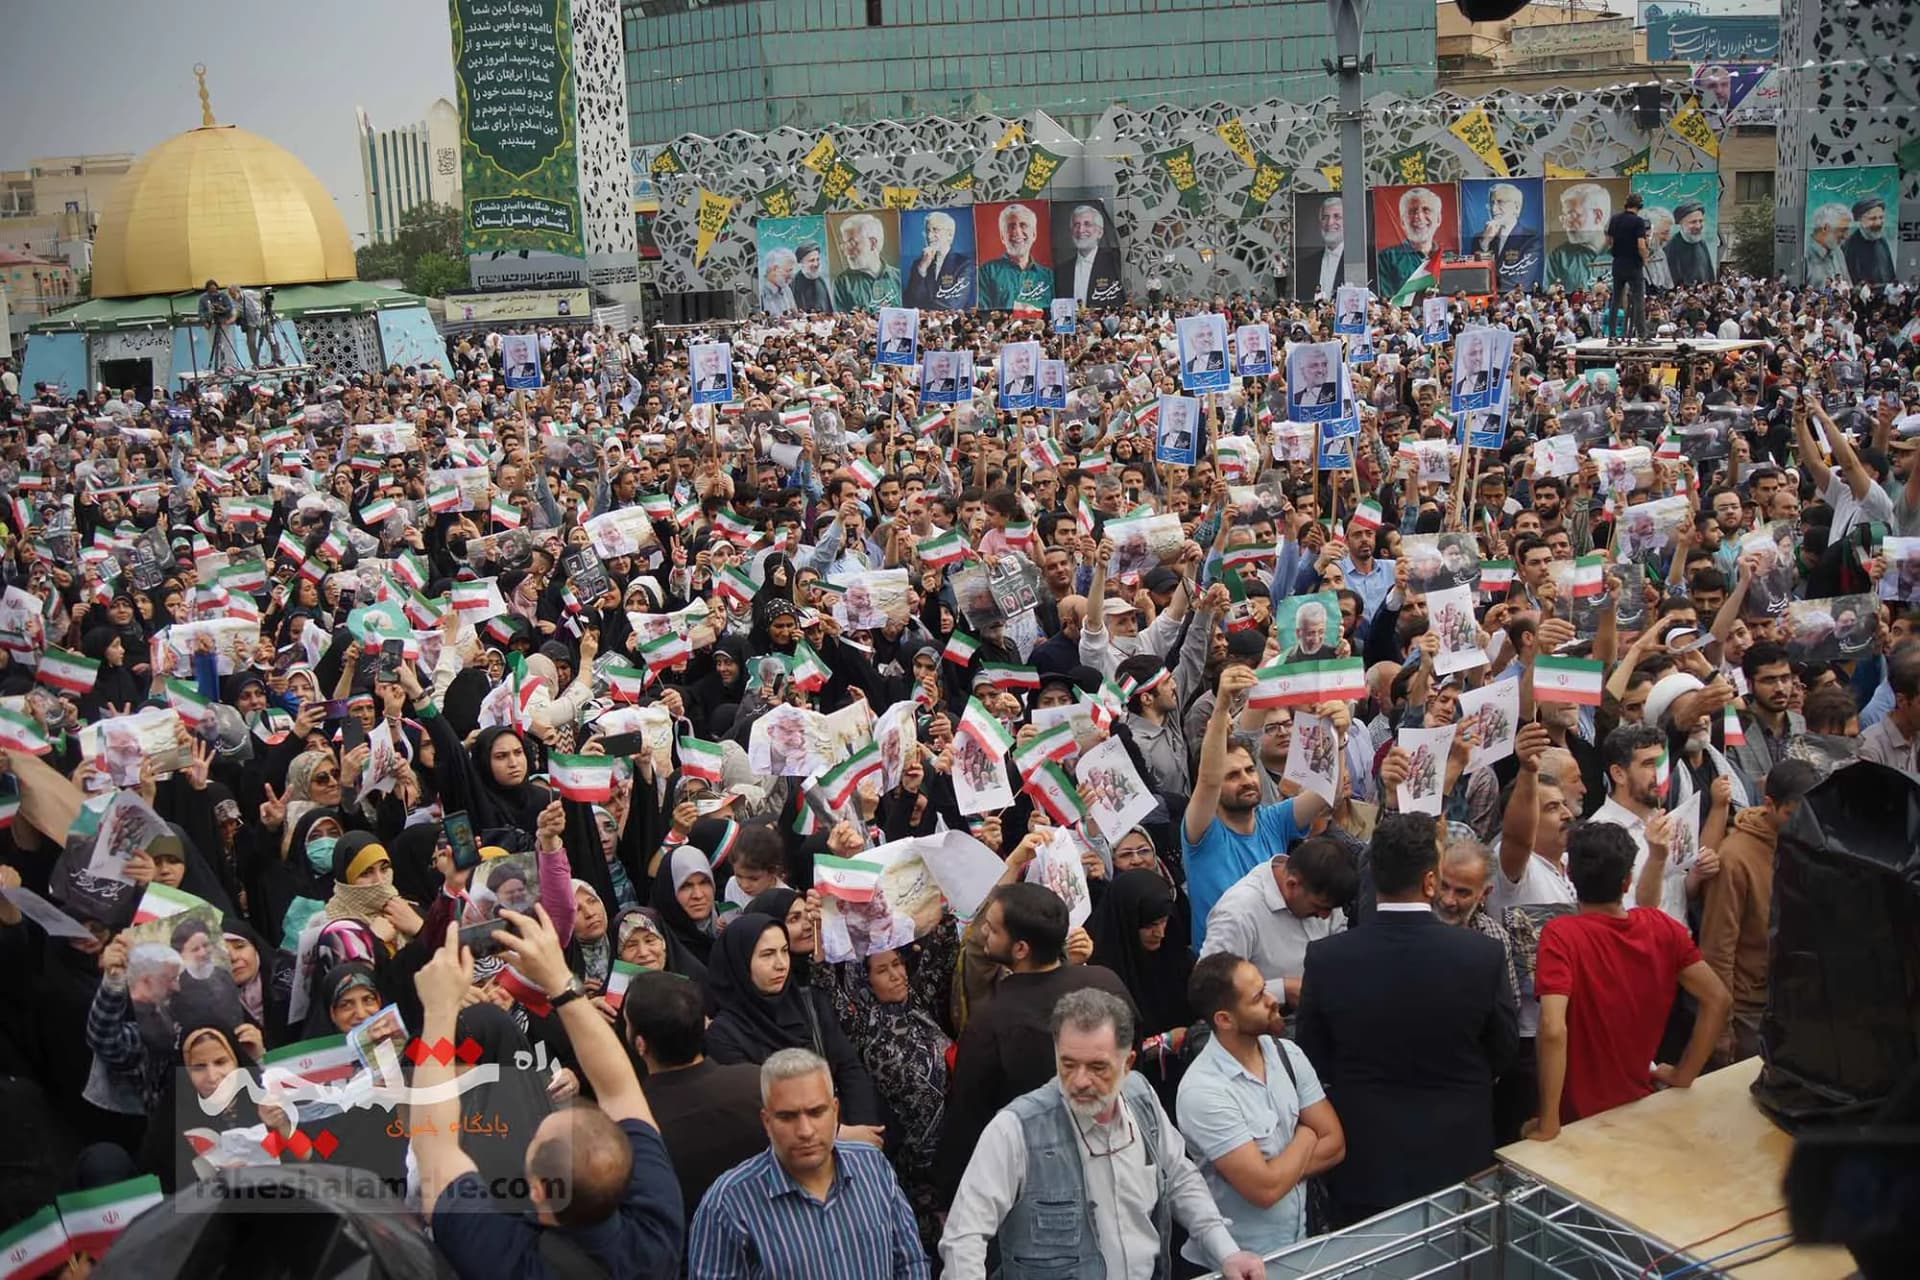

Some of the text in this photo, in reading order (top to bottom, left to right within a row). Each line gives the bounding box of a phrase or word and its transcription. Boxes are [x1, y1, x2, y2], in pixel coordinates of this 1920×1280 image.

[471, 4, 490, 15] شما
[491, 5, 507, 16] دین
[522, 21, 528, 32] و
[464, 39, 473, 53] از
[475, 41, 481, 51] و
[529, 37, 538, 50] از
[539, 43, 555, 55] پس
[467, 57, 483, 69] دین
[484, 52, 508, 66] امروز
[541, 58, 555, 69] من
[473, 69, 495, 85] کامل
[532, 70, 551, 83] شما
[473, 88, 481, 101] را
[482, 86, 500, 99] خود
[501, 86, 526, 97] نعمت
[481, 103, 507, 117] نمودم
[508, 101, 526, 116] تمام
[471, 118, 559, 135] دین اسلام را برای شما
[474, 201, 501, 214] دشمنان
[475, 213, 507, 227] ایمان
[507, 211, 532, 227] اهل
